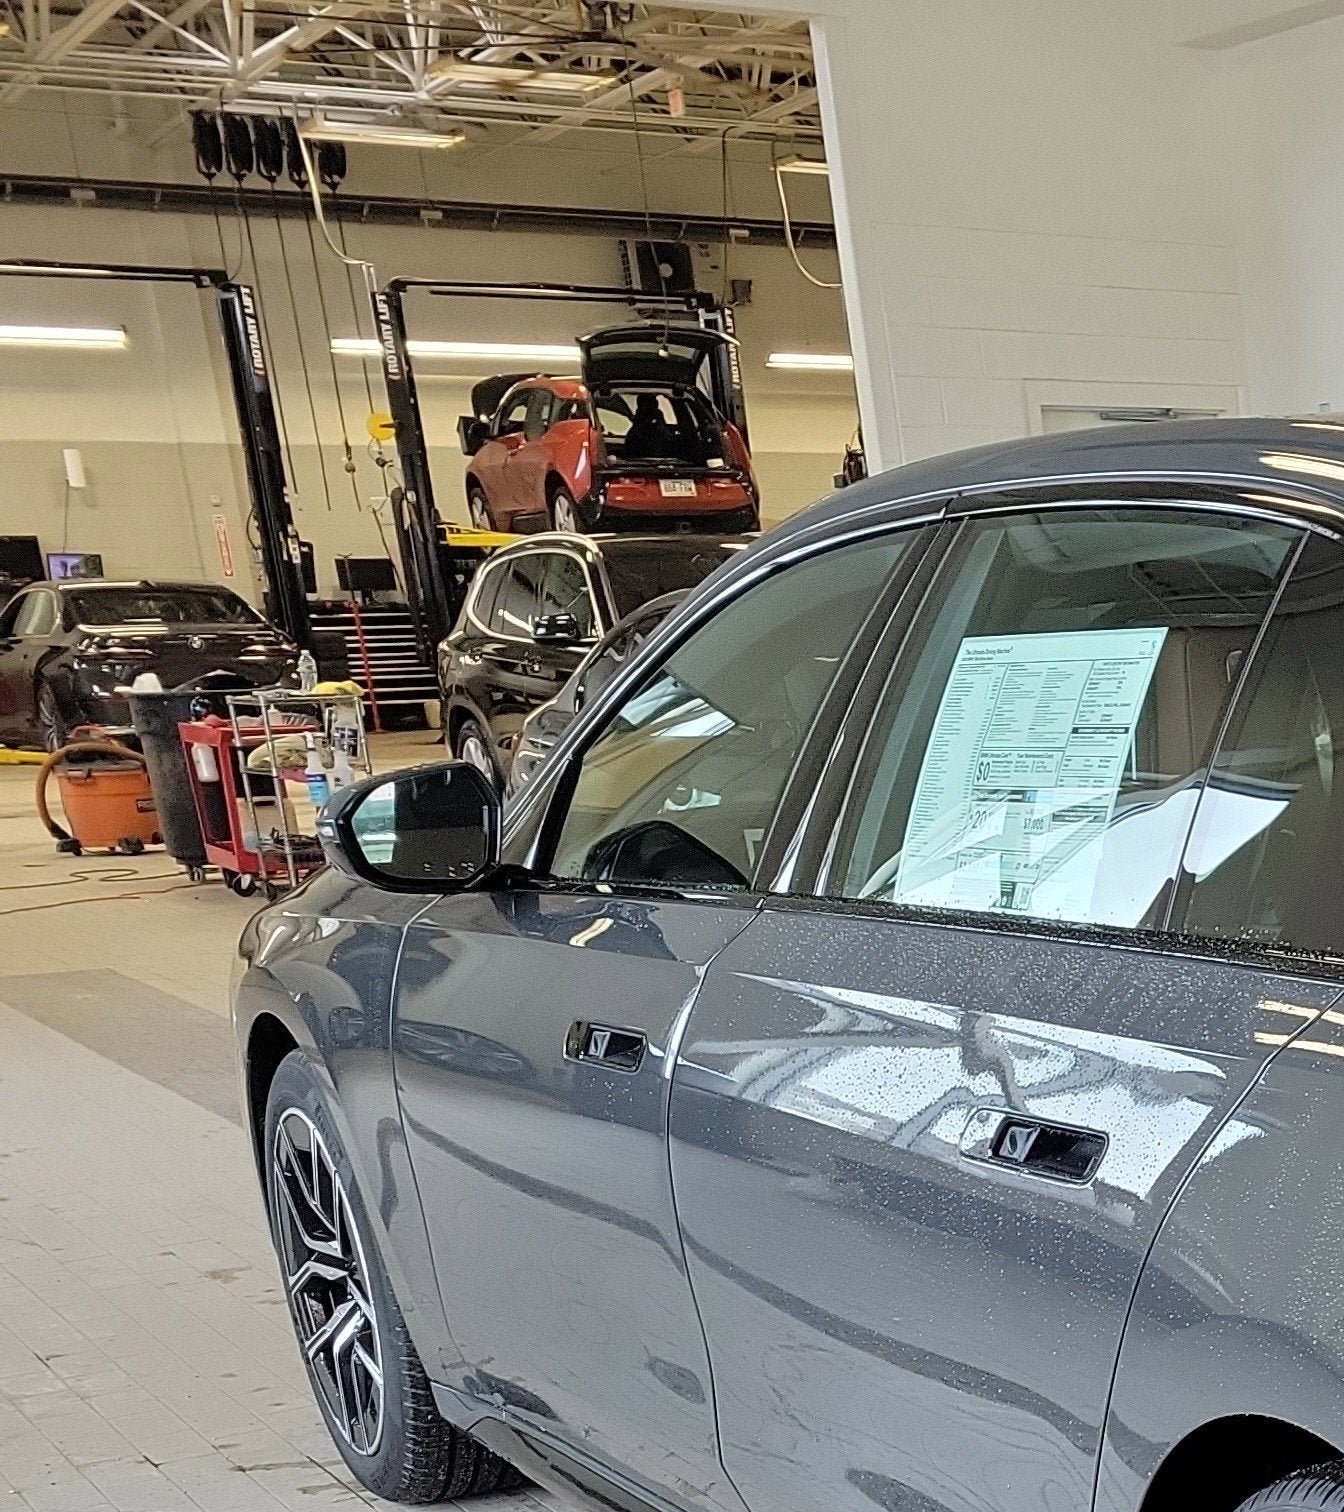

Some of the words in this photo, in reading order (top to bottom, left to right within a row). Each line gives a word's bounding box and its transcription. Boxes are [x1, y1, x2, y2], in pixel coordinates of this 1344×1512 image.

[240, 285, 255, 316] LIFT
[376, 293, 390, 320] LIFT
[976, 760, 991, 782] $0
